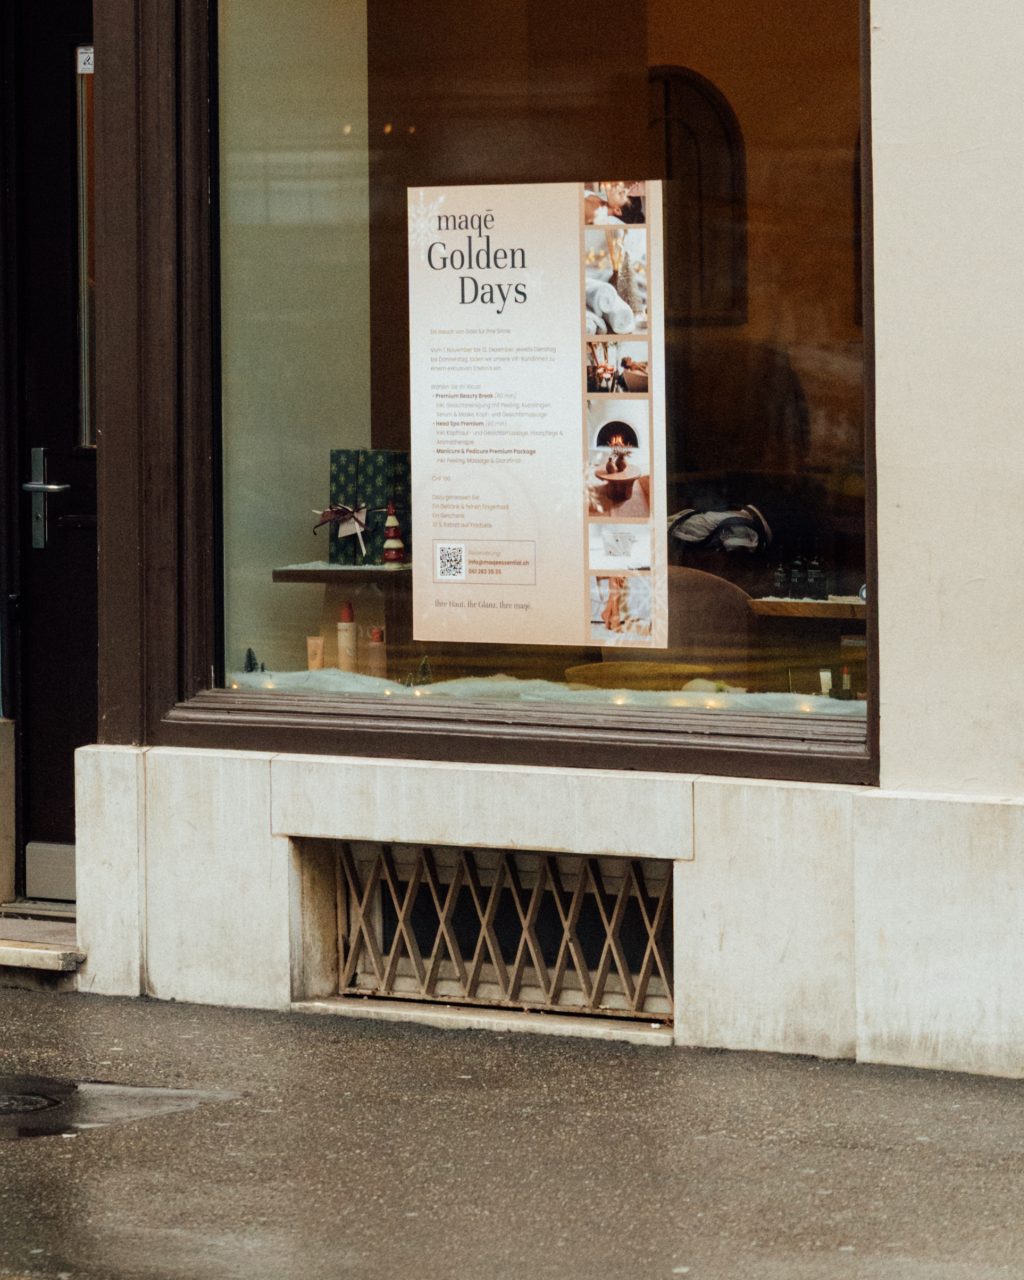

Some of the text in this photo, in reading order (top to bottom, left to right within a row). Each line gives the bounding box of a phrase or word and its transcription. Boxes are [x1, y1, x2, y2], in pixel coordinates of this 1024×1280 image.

[437, 209, 495, 238] maqē
[427, 236, 527, 270] Golden
[459, 276, 528, 314] Days
